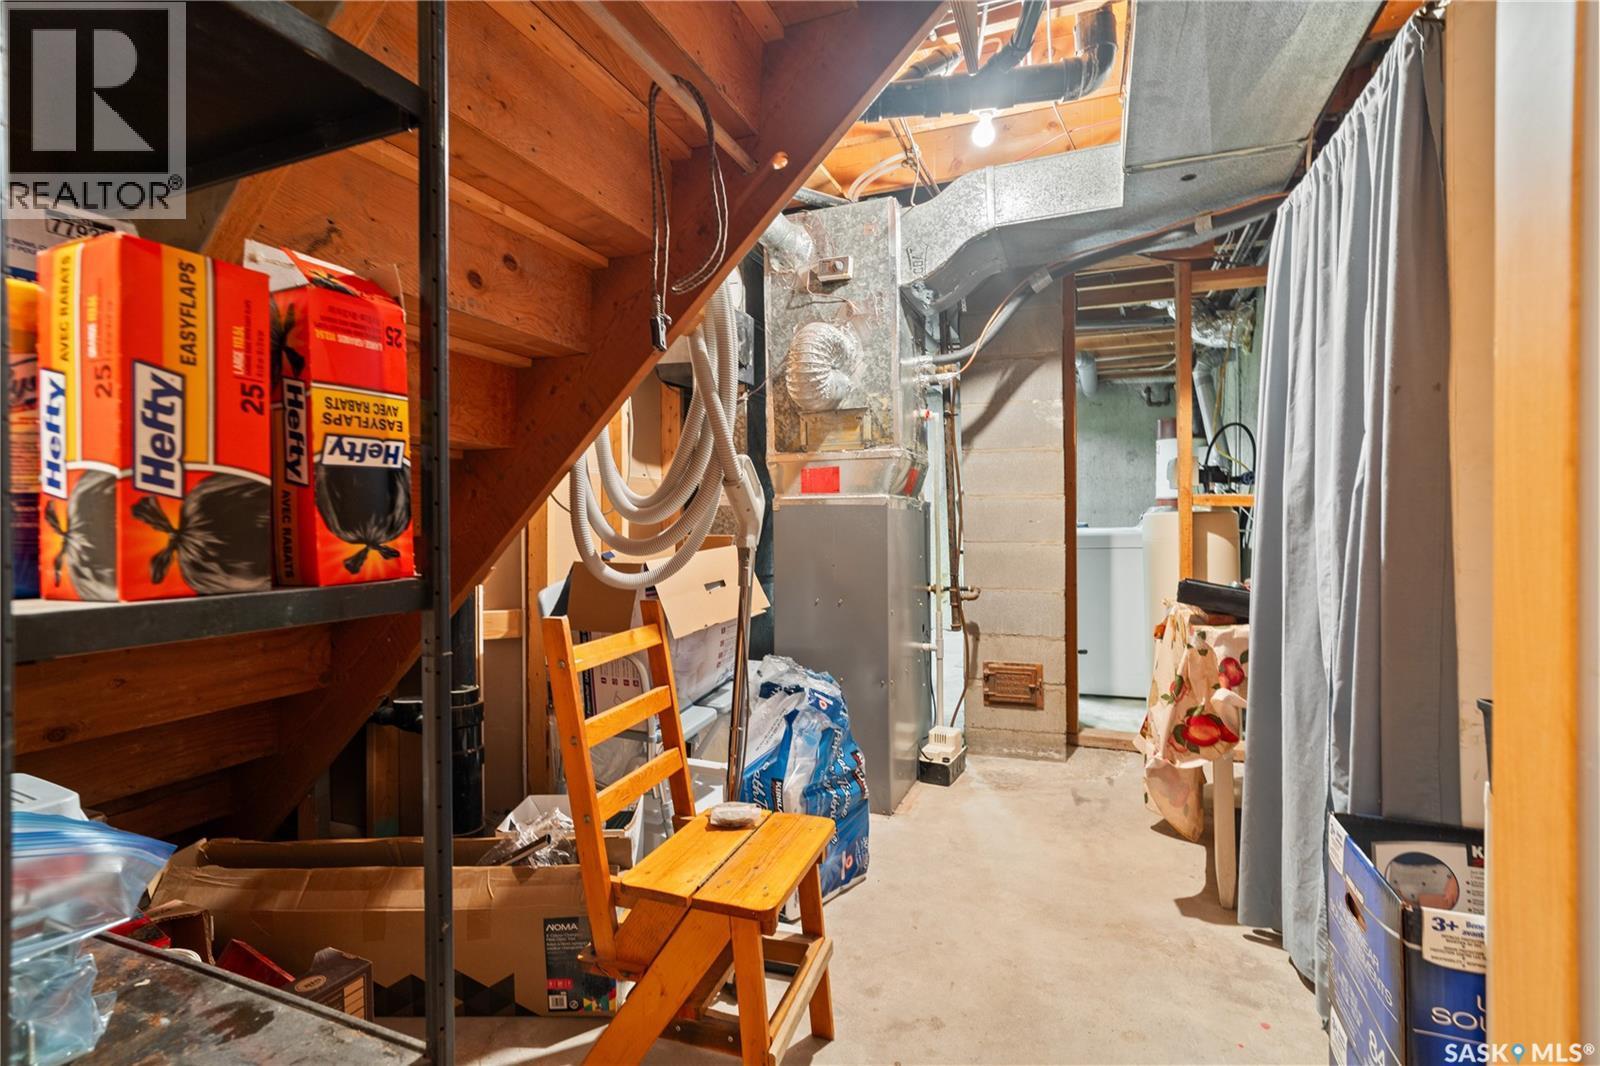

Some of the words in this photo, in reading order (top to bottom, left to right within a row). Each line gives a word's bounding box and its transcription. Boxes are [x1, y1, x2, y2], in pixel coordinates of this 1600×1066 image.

[60, 255, 71, 316] RABATS
[180, 260, 197, 367] EASYFLAPS
[60, 321, 70, 362] AVEC
[386, 326, 402, 348] 25
[94, 362, 113, 399] 25
[240, 382, 265, 416] 25
[324, 396, 370, 414] RABATS
[373, 403, 399, 417] AVEC
[45, 378, 66, 491] Hefty
[140, 372, 184, 490] Hefty
[285, 384, 306, 480] Hefty
[322, 412, 403, 432] EASYFLAPS
[328, 436, 401, 465] Hefty
[281, 490, 292, 524] AVEC
[283, 527, 294, 579] RABATS
[546, 923, 578, 932] NOMA
[1432, 916, 1459, 932] 3+
